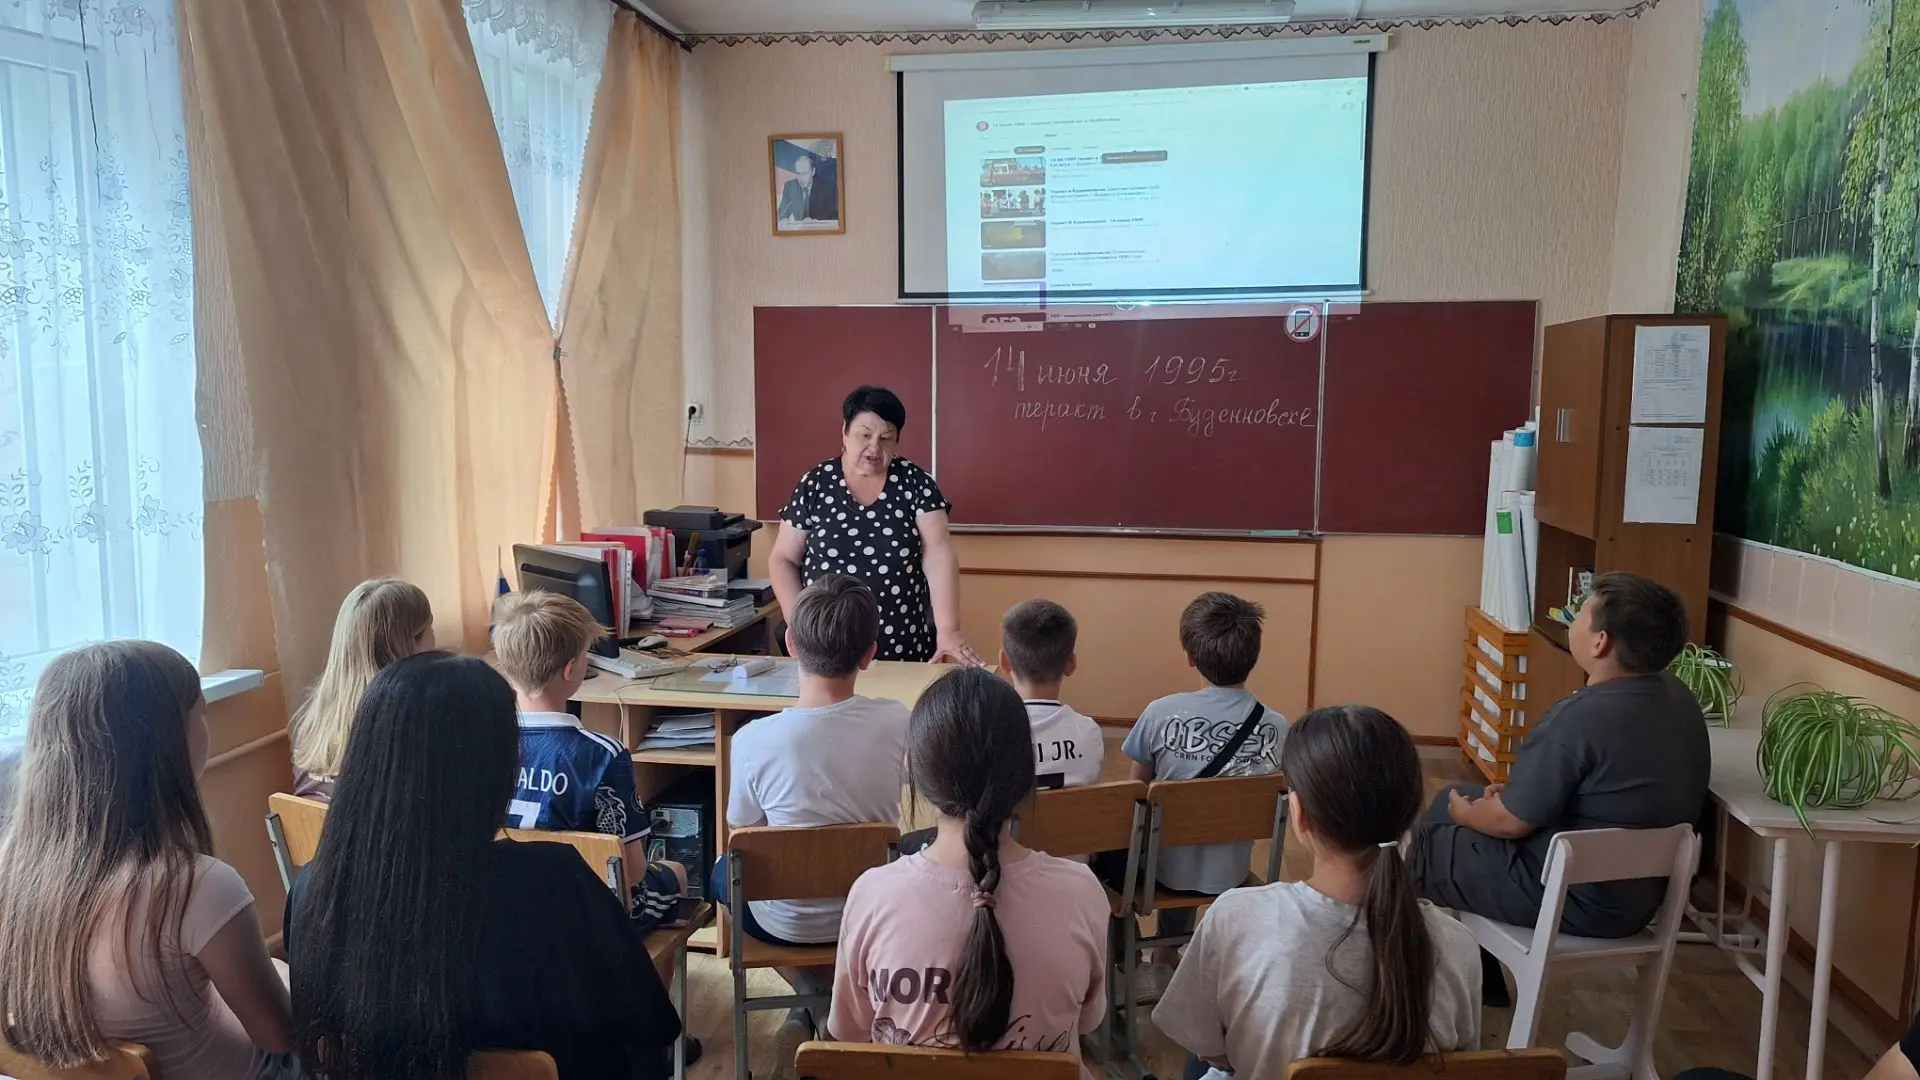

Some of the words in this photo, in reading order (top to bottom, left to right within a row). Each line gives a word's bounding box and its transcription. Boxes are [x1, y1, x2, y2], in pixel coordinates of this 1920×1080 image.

[984, 345, 1025, 391] 14
[1037, 362, 1118, 386] июня
[1014, 399, 1107, 431] теракт
[1127, 396, 1142, 421] в
[1037, 743, 1044, 763] I
[1052, 740, 1083, 761] JR.
[1201, 754, 1214, 763] FO
[517, 766, 568, 795] ALDO
[870, 967, 952, 1005] WOR
